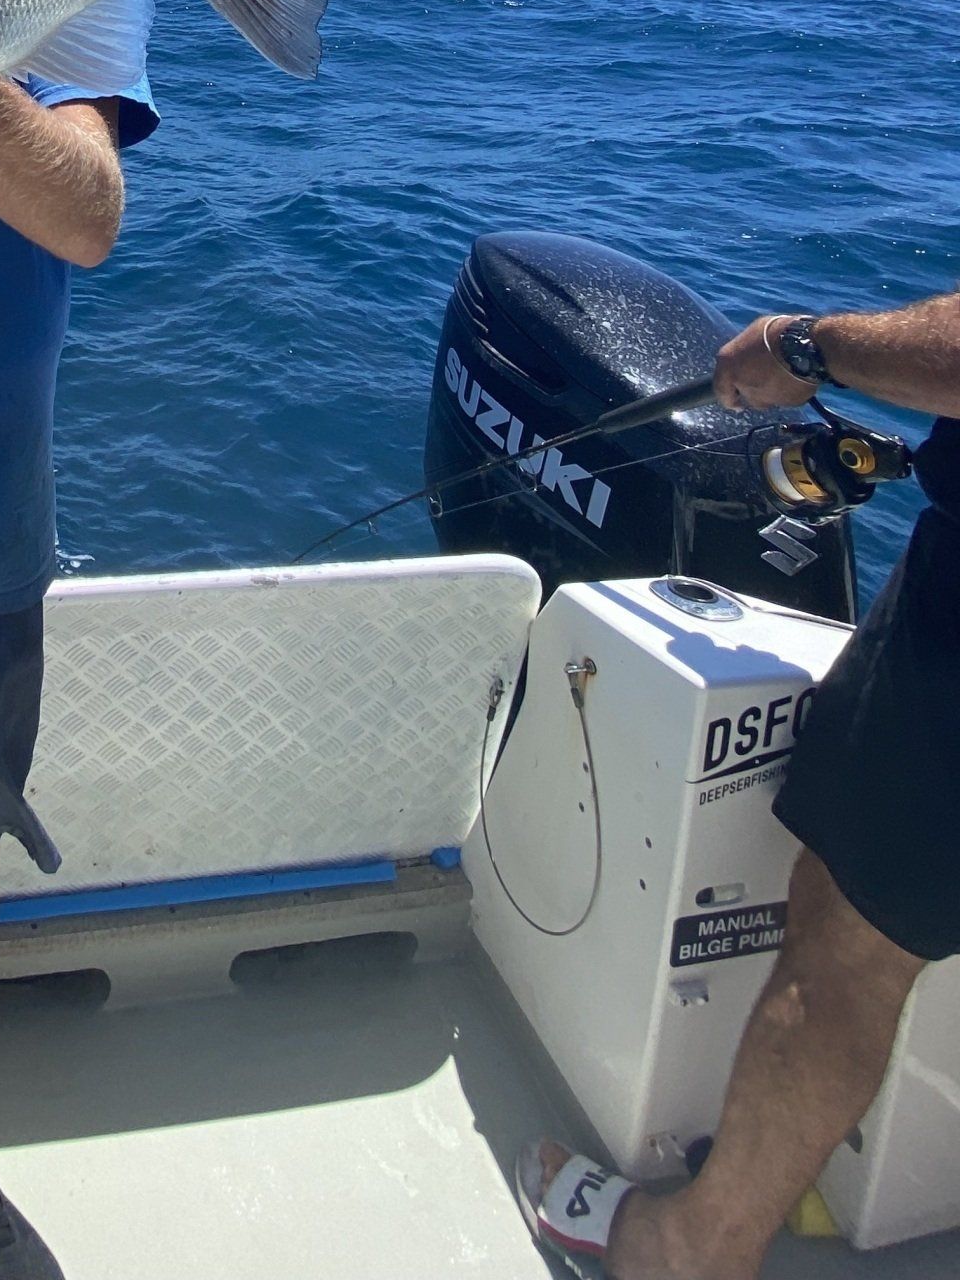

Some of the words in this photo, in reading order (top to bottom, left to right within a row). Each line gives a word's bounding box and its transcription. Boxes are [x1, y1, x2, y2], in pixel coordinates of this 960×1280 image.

[444, 347, 611, 528] SUZUKI
[698, 910, 775, 936] MANUAL
[679, 937, 733, 960] BILGE
